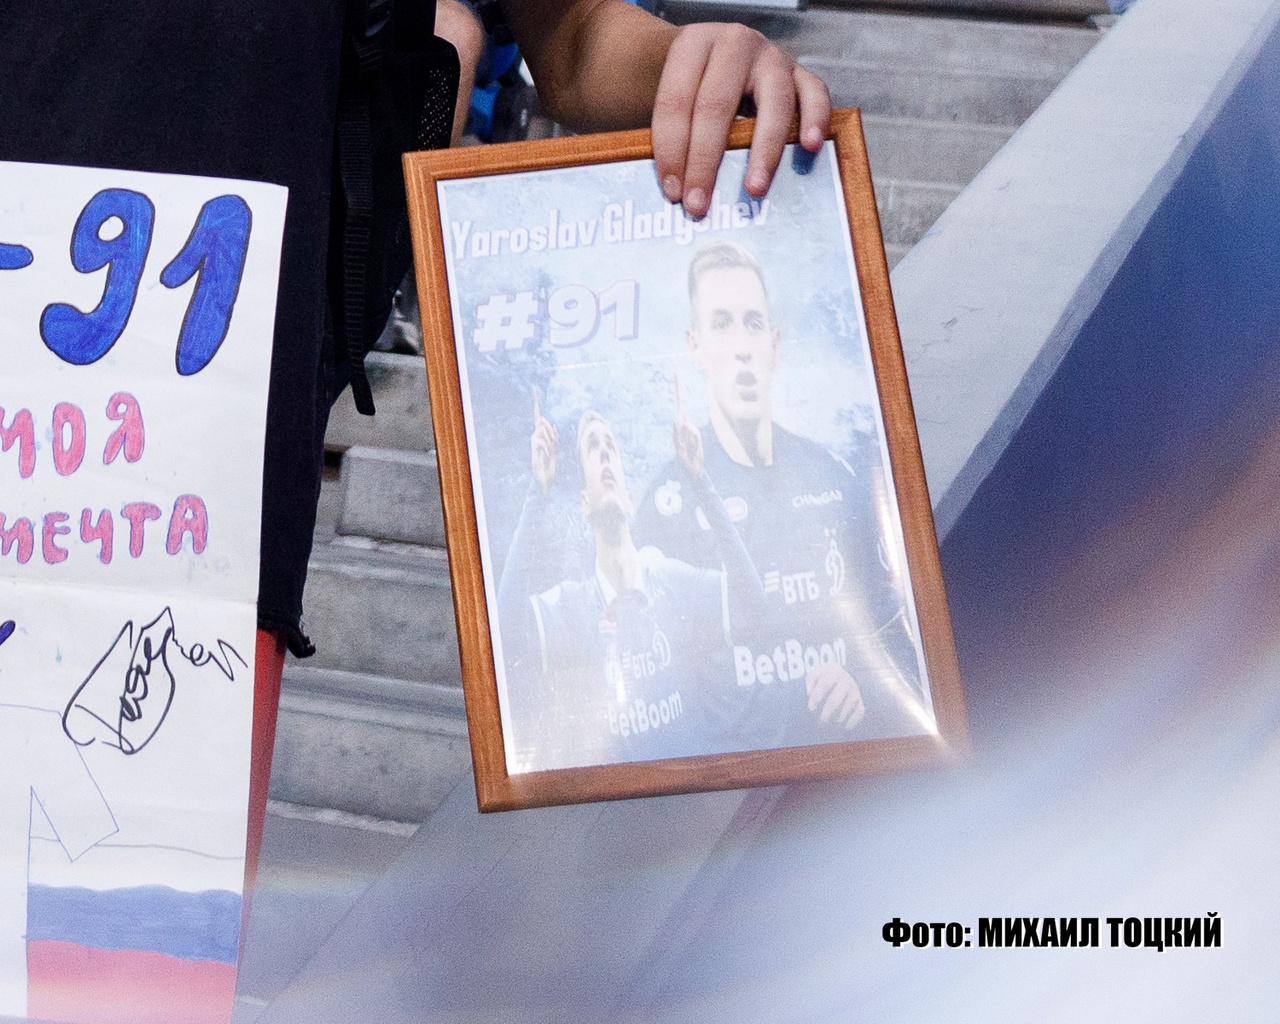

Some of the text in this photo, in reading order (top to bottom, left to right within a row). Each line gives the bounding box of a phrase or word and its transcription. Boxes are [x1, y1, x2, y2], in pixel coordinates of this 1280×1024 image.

[451, 207, 599, 260] Yaroslav
[473, 279, 640, 353] #91
[607, 689, 684, 738] BetBoom
